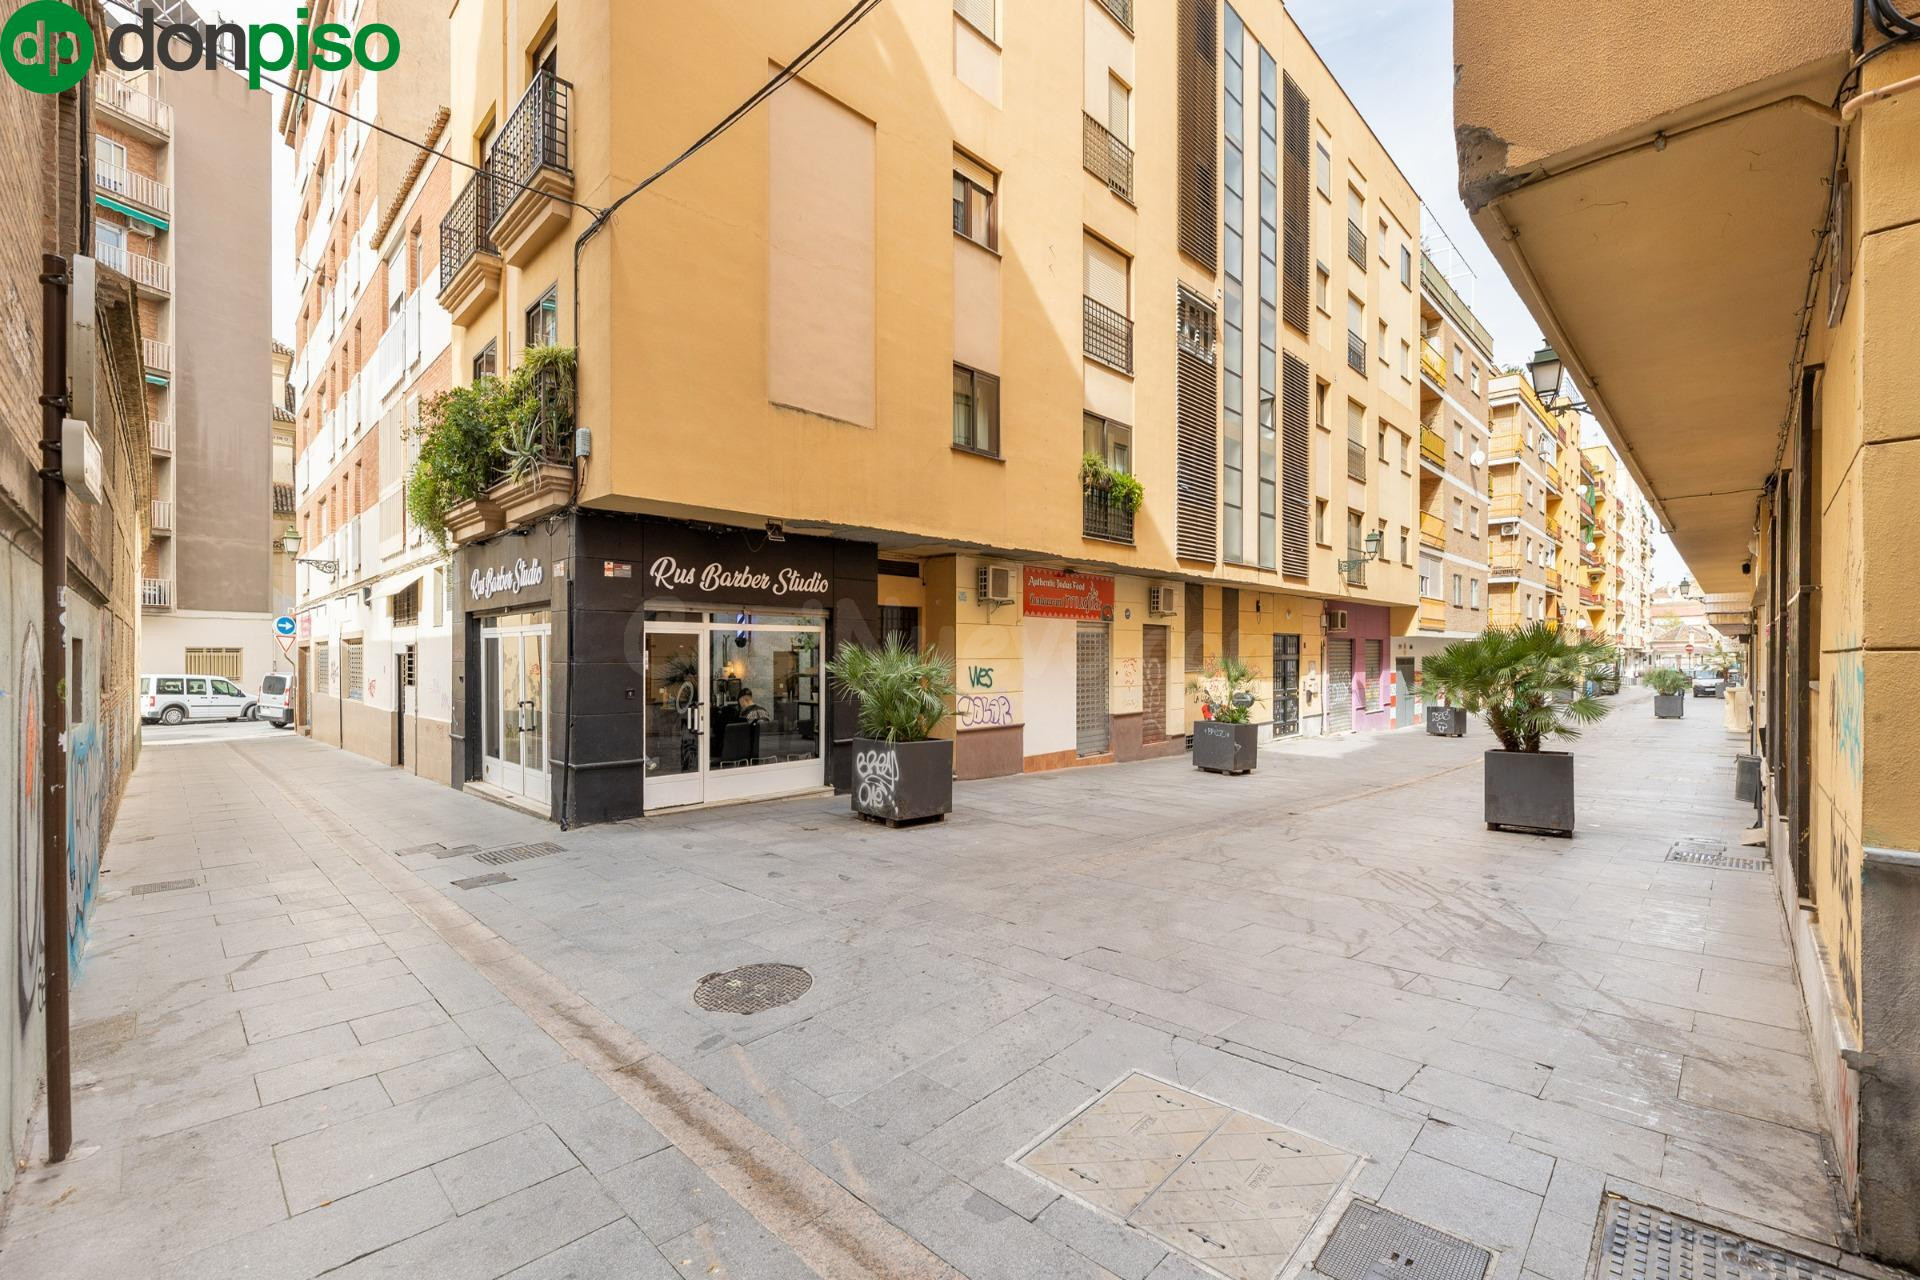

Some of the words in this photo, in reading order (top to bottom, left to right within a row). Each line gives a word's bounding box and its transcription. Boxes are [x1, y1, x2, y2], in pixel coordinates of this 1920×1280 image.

[470, 568, 485, 600] Rus
[485, 565, 513, 599] Barber
[512, 557, 543, 594] Studio
[649, 556, 696, 590] Rus
[699, 562, 771, 592] Barber
[772, 567, 829, 595] Studio
